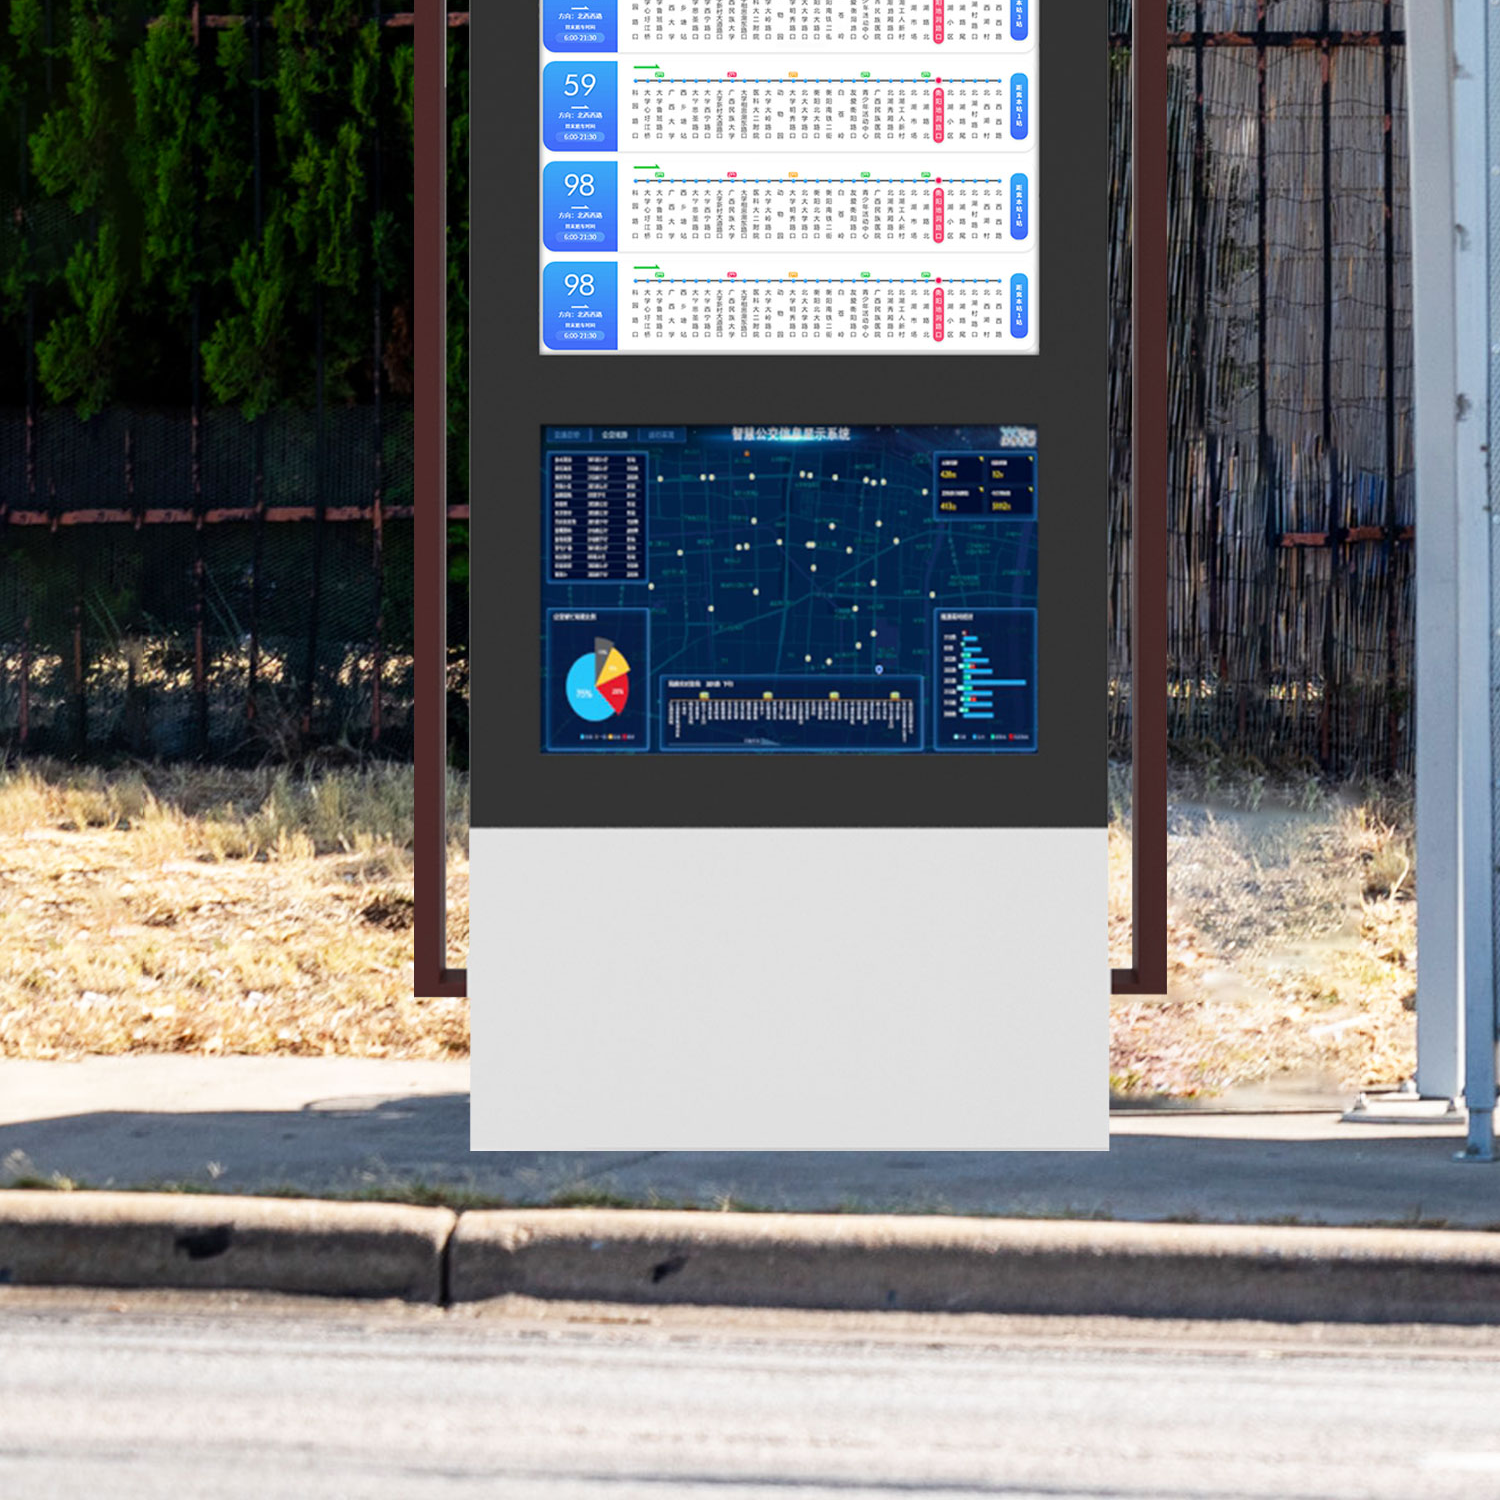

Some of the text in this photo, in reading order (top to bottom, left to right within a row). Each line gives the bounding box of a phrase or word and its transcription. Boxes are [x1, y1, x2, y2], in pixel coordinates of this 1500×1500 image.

[564, 34, 597, 42] 6:00-21:30
[564, 73, 596, 96] 59
[564, 133, 597, 141] 6:00-21:30
[564, 173, 595, 197] 98
[564, 233, 597, 241] 6:00-21:30
[564, 273, 595, 296] 98
[564, 332, 597, 340] 6:00-21:30
